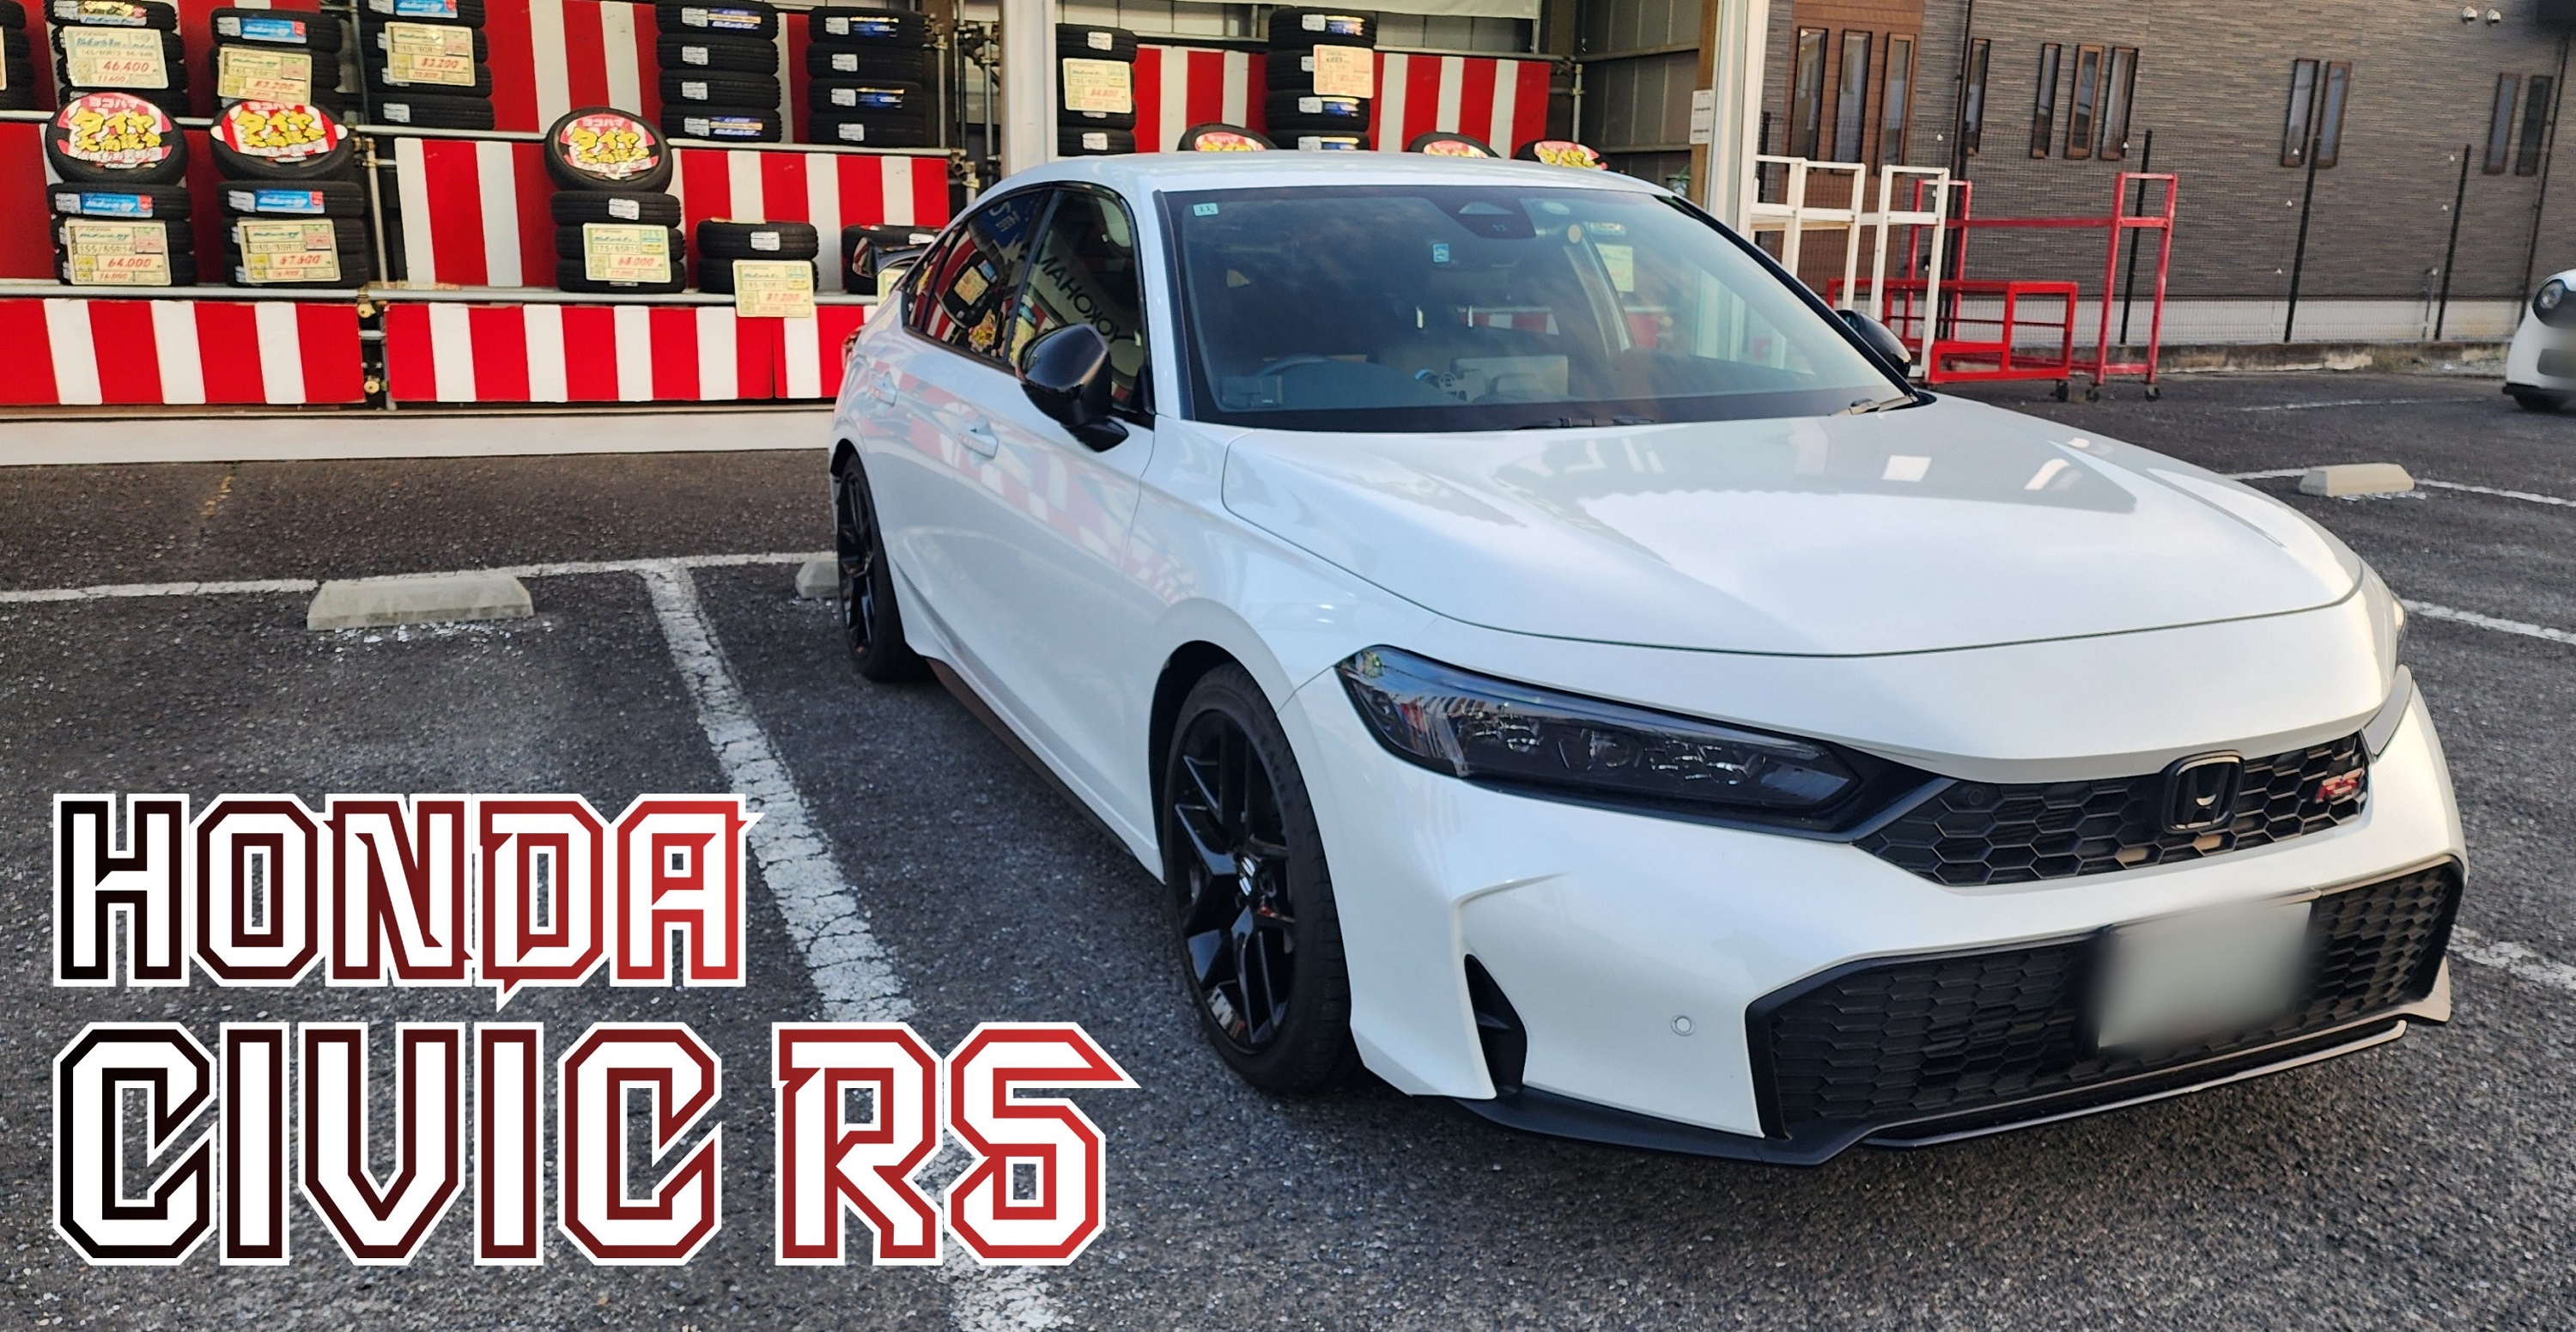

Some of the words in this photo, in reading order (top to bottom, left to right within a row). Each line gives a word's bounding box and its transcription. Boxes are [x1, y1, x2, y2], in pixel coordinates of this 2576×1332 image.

[89, 96, 139, 108] ヨコハマ
[70, 107, 155, 137] タイヤ
[234, 110, 314, 137] タイヤ
[582, 119, 624, 127] ヨコハマ
[569, 127, 640, 151] タイヤ
[2316, 768, 2365, 804] RS
